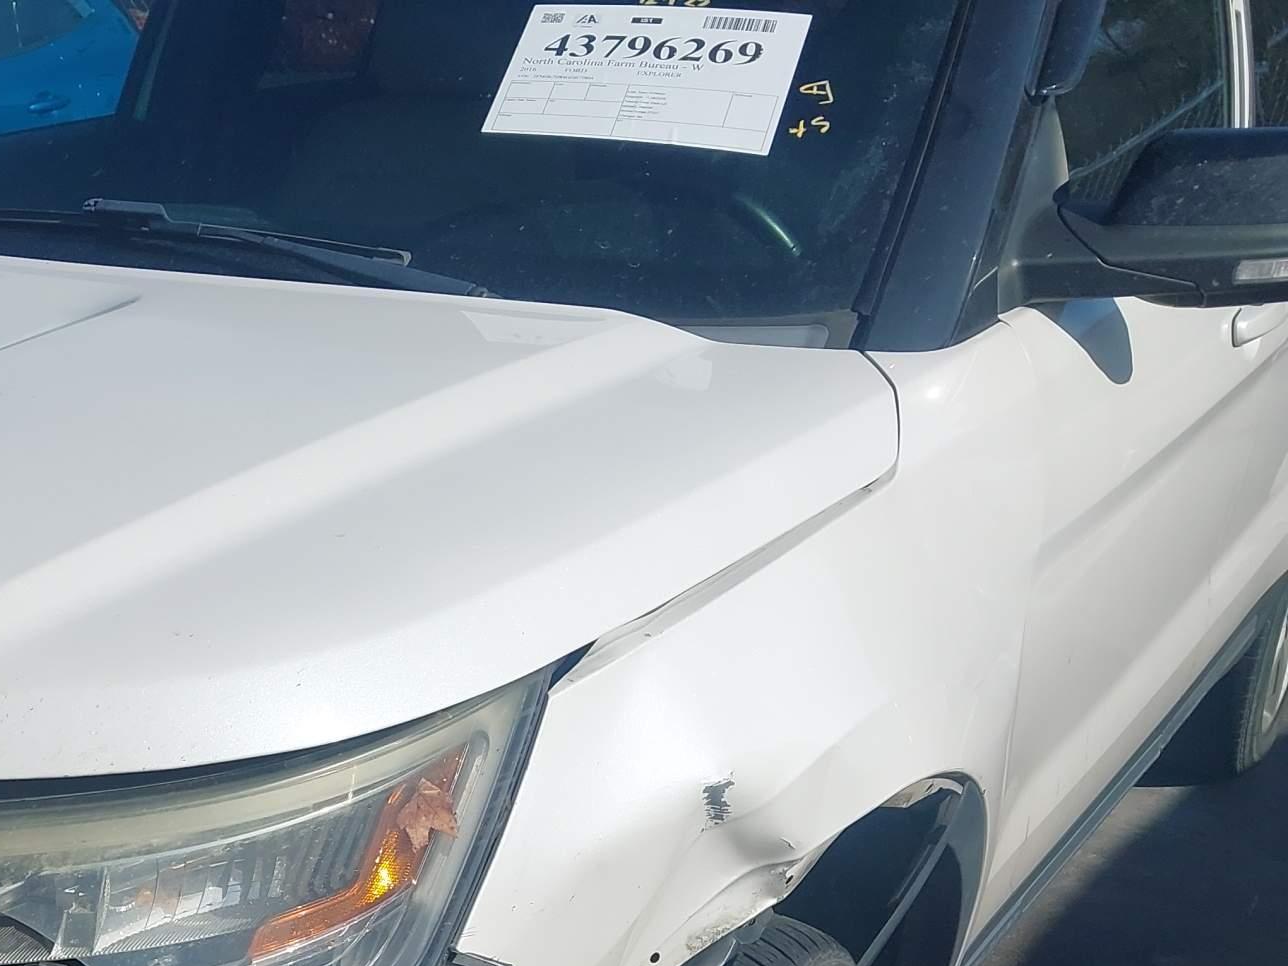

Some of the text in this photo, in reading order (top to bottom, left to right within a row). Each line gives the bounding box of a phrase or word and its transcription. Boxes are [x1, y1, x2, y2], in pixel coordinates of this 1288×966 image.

[544, 33, 764, 65] 43796269
[523, 57, 553, 66] North
[557, 59, 603, 68] Carolina
[607, 60, 635, 68] Farm
[639, 61, 679, 70] Bureau
[691, 63, 704, 71] W
